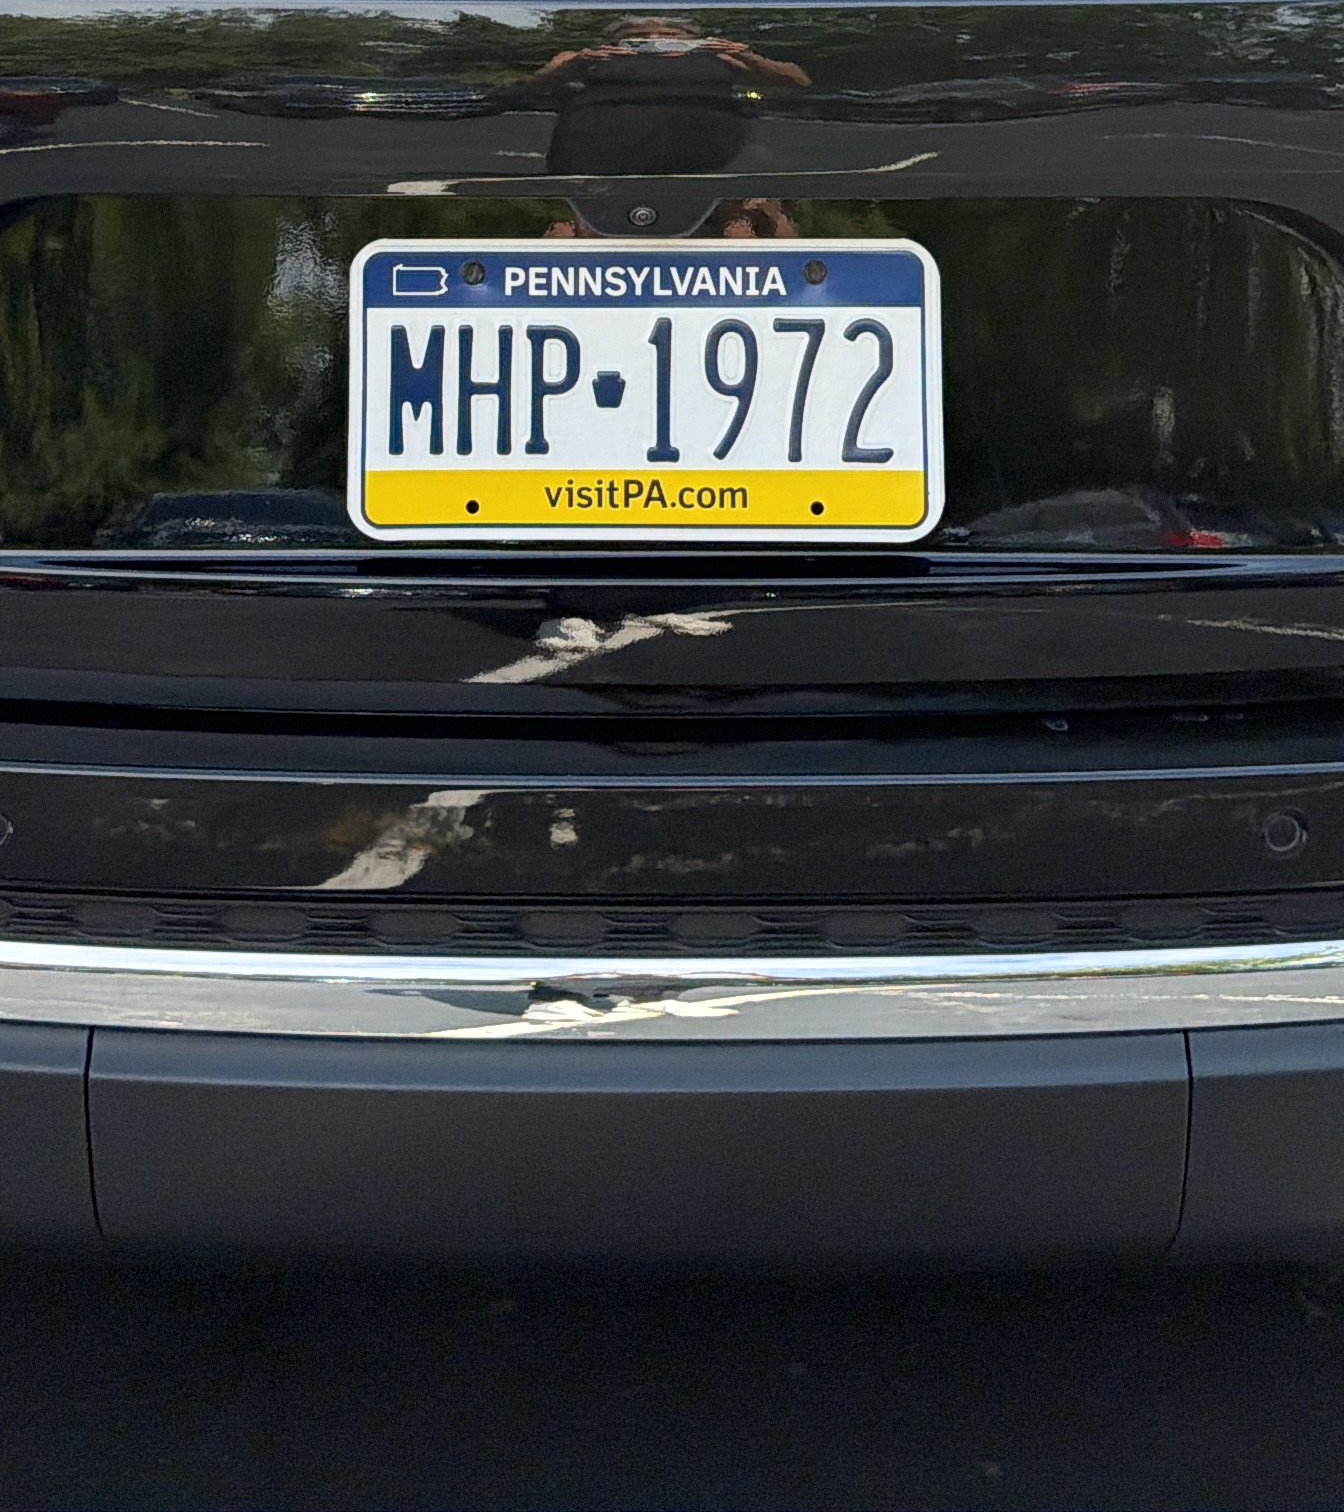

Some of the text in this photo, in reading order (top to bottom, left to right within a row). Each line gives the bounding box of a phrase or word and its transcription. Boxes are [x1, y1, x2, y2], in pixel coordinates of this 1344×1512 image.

[503, 265, 788, 296] PENNSYLVANIA
[646, 317, 894, 463] 1972
[544, 478, 749, 510] visitPA.com
